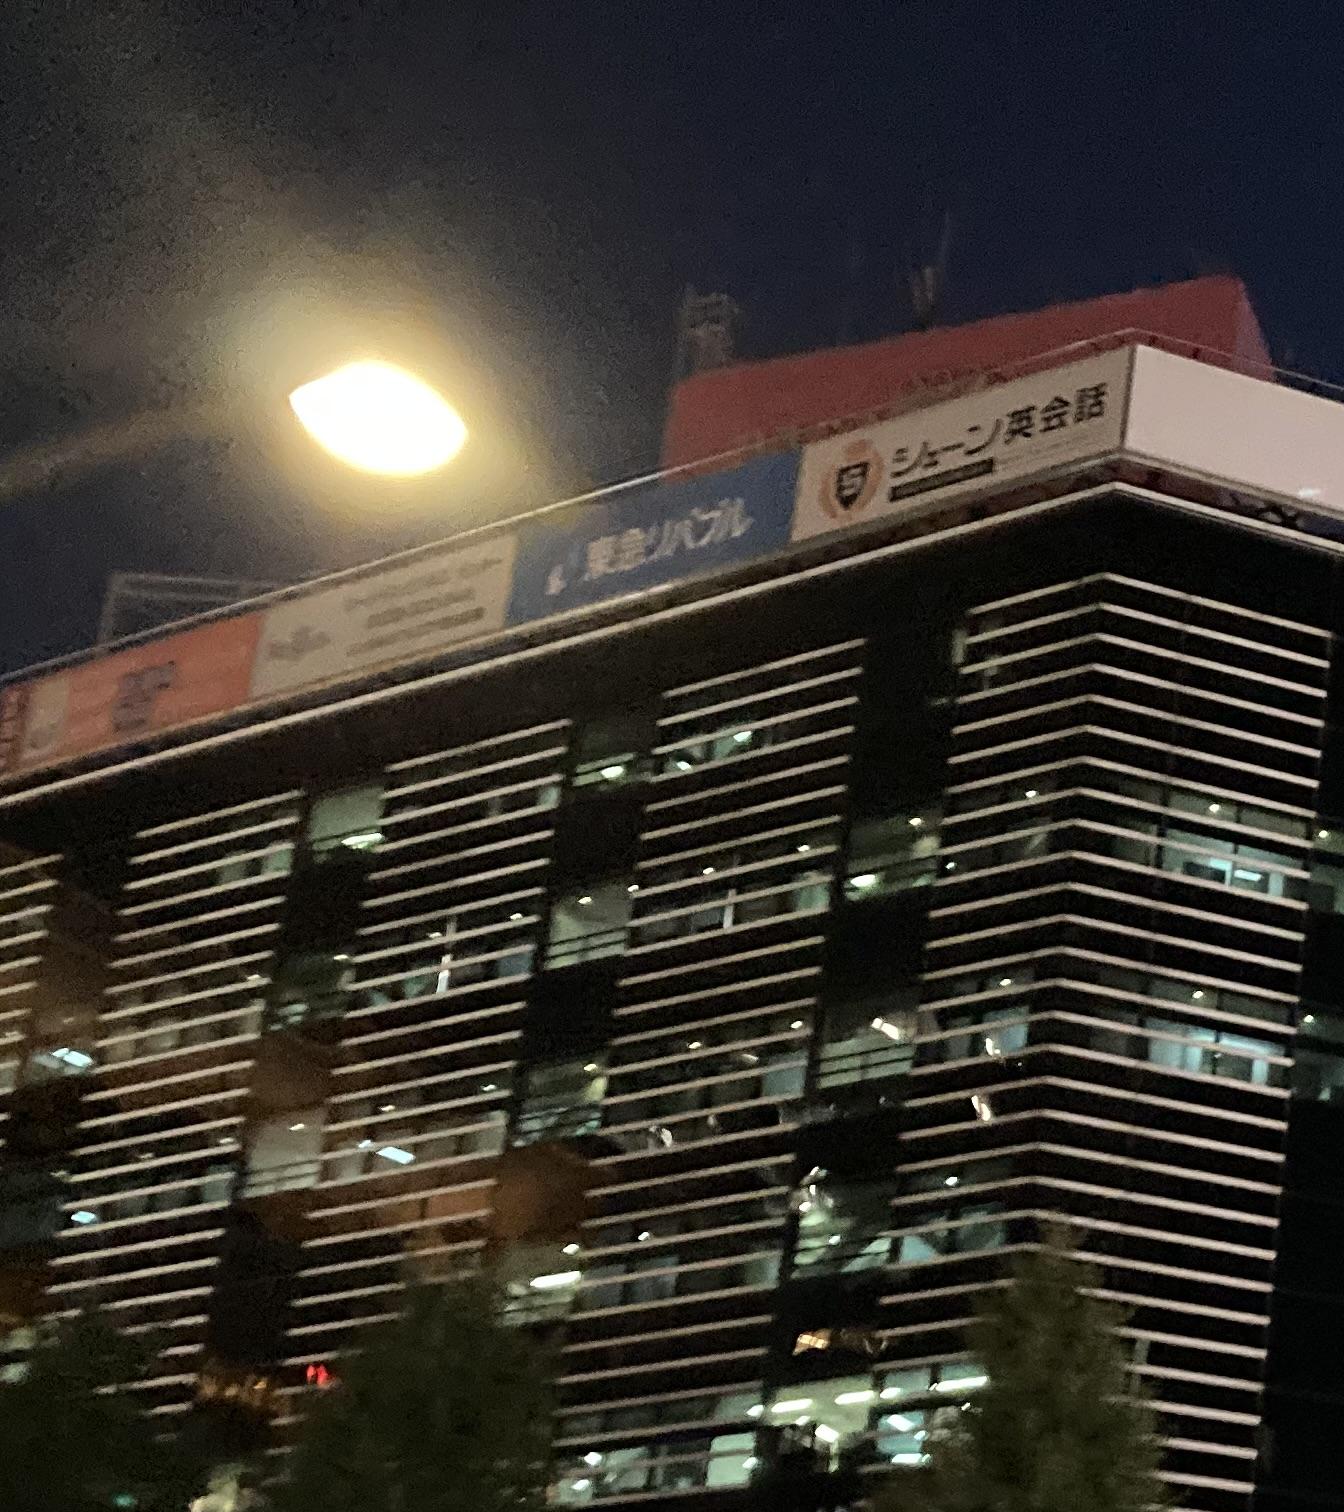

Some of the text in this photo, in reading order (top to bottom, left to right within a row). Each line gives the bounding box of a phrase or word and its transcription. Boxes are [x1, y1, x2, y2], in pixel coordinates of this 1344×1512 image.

[889, 382, 1108, 478] シェーン英会話
